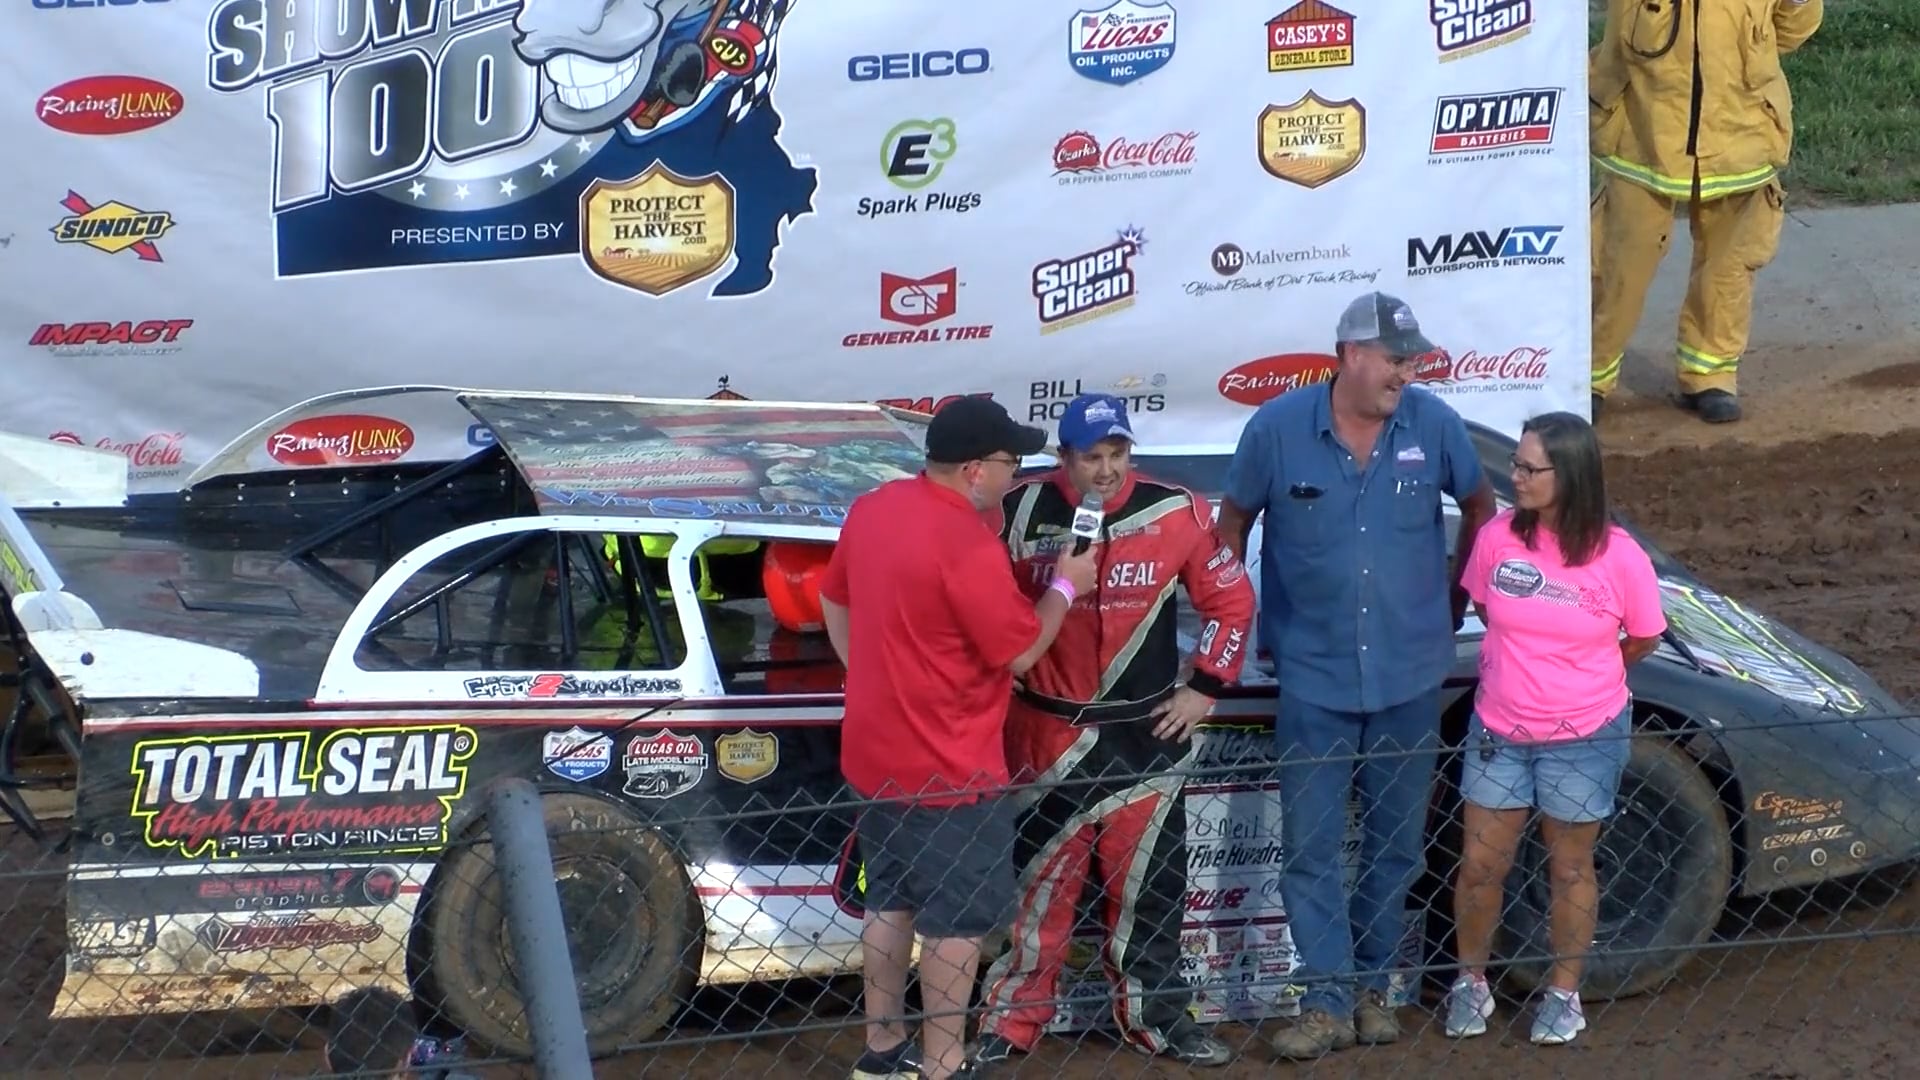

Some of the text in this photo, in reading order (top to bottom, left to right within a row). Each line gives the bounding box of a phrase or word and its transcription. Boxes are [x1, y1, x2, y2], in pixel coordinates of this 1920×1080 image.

[1274, 22, 1347, 46] CASEY'S
[1441, 1, 1526, 47] Clean
[1081, 21, 1169, 50] LUCAS
[711, 36, 748, 67] GUS
[1076, 47, 1170, 67] OIL PRODUCTS
[1274, 48, 1348, 66] GENERAL STORE
[847, 47, 990, 82] GEICO
[1111, 66, 1137, 77] INC.
[266, 18, 546, 216] 100
[1277, 112, 1345, 129] PROTECT
[1440, 95, 1550, 131] OPTIMA
[1278, 131, 1345, 148] HARVEST
[1302, 125, 1321, 135] THE
[1460, 129, 1528, 147] BATTERIES
[1056, 143, 1097, 164] Ozarks
[1072, 174, 1104, 185] PEPPER
[1105, 171, 1148, 182] BOTTLING
[1149, 167, 1193, 178] COMPANY
[609, 194, 706, 214] PROTECT
[856, 192, 982, 219] Spark Plugs
[59, 214, 167, 239] SUNOCO
[643, 210, 672, 222] THE
[390, 221, 565, 245] PRESENTED BY
[613, 219, 707, 241] HARVEST
[681, 233, 708, 246] .com
[1036, 244, 1132, 294] Super
[1215, 250, 1241, 268] MB
[1407, 256, 1566, 278] MOTORSPORTS NETWORK
[1231, 277, 1263, 291] Bank
[1263, 276, 1275, 290] of
[1306, 270, 1336, 285] Track
[889, 283, 949, 316] GT
[1043, 271, 1130, 319] Clean
[28, 318, 195, 346] IMPACT
[841, 324, 994, 348] GENERAL TIRE
[1030, 378, 1082, 400] BILL
[1455, 384, 1499, 394] BOTTLING
[1500, 382, 1544, 392] COMPANY
[136, 468, 181, 480] COMPANY
[1106, 561, 1158, 588] SEAL
[634, 742, 695, 754] LUCAS OIL
[143, 733, 459, 805] TOTAL SEAL
[626, 757, 650, 767] LATE
[650, 756, 683, 765] MODEL
[683, 756, 705, 765] DIRT
[150, 797, 442, 848] High Performance
[220, 825, 440, 850] PISTON RINGS
[1189, 844, 1226, 869] Five
[1225, 840, 1284, 867] Hundre
[234, 893, 346, 910] graphics
